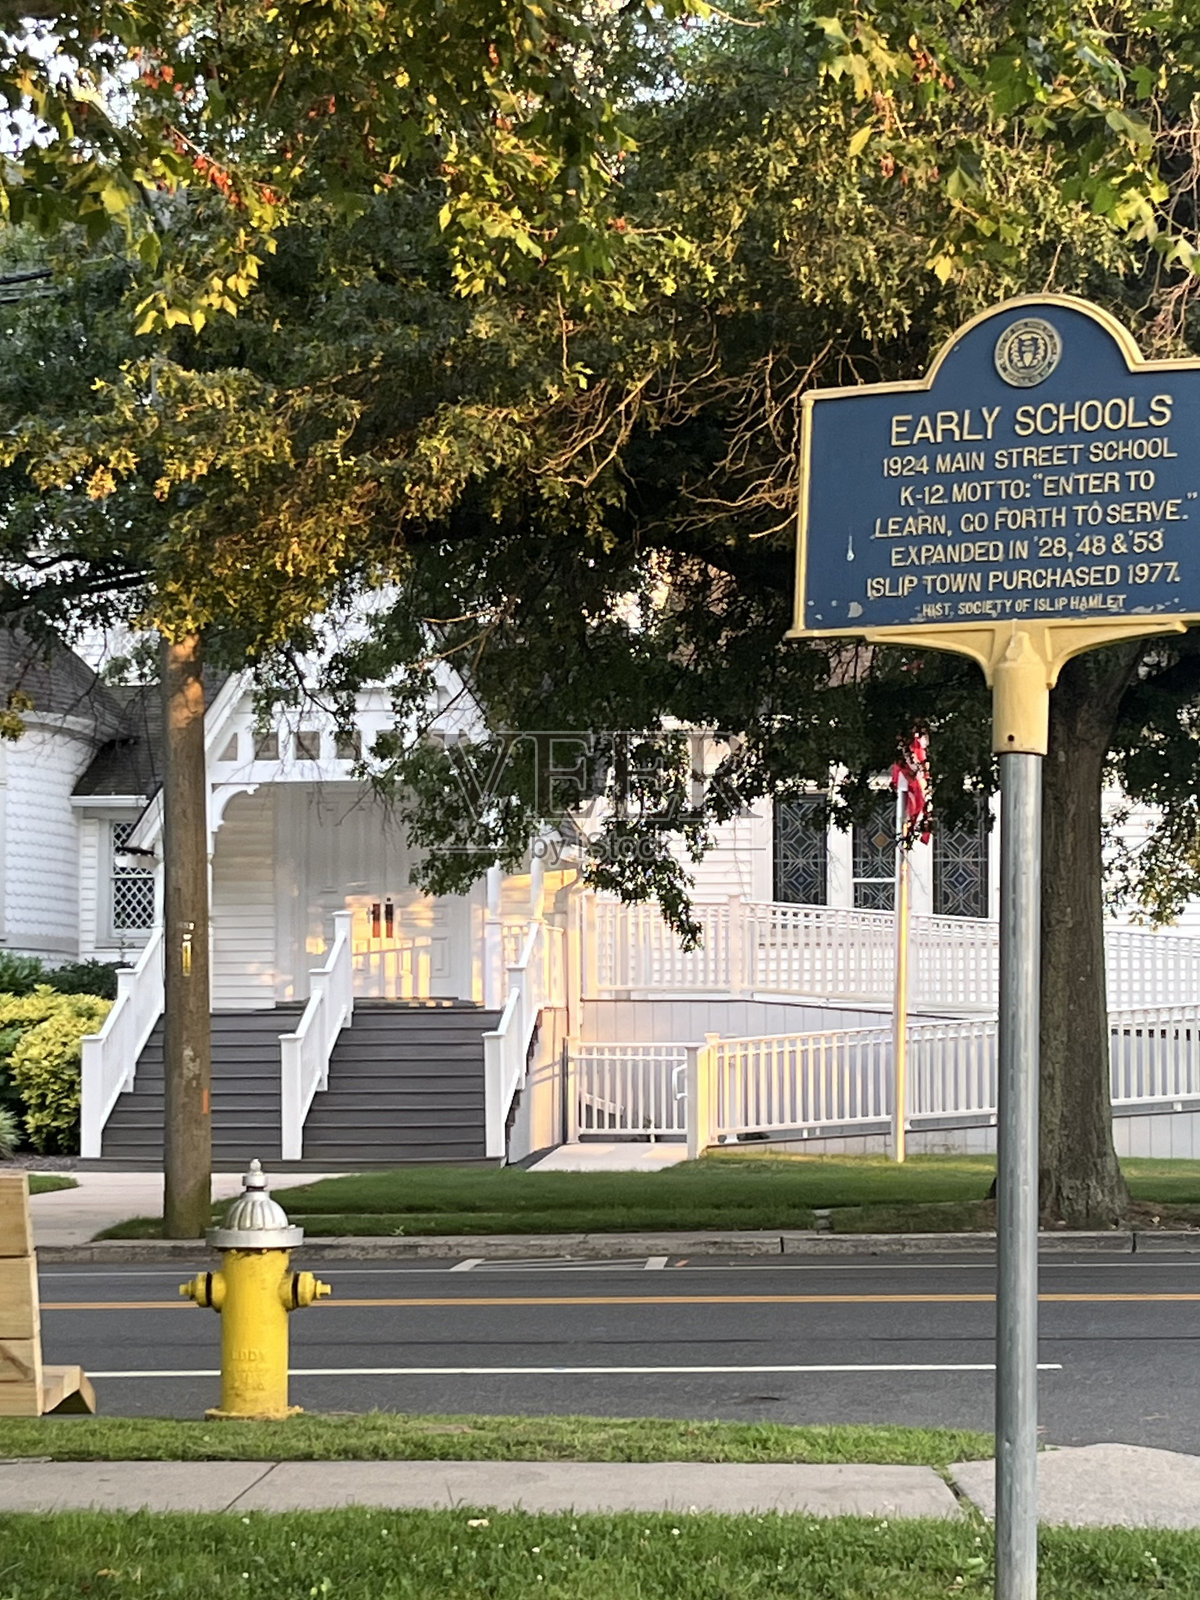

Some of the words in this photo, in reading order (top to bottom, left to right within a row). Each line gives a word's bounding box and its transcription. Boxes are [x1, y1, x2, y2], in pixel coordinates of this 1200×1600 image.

[890, 406, 1001, 446] EARLY
[1014, 394, 1174, 436] SCHOOLS
[883, 455, 929, 477] 1924
[935, 451, 985, 473] MAIN
[994, 443, 1085, 469] STREET
[1089, 437, 1178, 462] SCHOOL
[952, 479, 1031, 503] MOTTO:
[1032, 471, 1121, 497] "ENTER
[1125, 470, 1155, 491] TO
[874, 514, 953, 538] LEARN,
[960, 512, 989, 533] GO
[994, 506, 1067, 531] FORTH
[1072, 504, 1103, 526] TO
[1106, 492, 1198, 525] SERVE."
[891, 541, 1004, 567] EXPANDED
[1008, 540, 1029, 560] IN
[1111, 533, 1128, 554] &
[867, 575, 918, 598] ISLIP
[922, 572, 981, 595] TOWN
[988, 564, 1121, 592] PURCHASED
[1127, 561, 1182, 585] 1977.
[957, 599, 1012, 616] SOCIETY
[1014, 598, 1032, 612] OF
[1033, 597, 1068, 611] ISLIP
[1070, 594, 1126, 611] HAMLET
